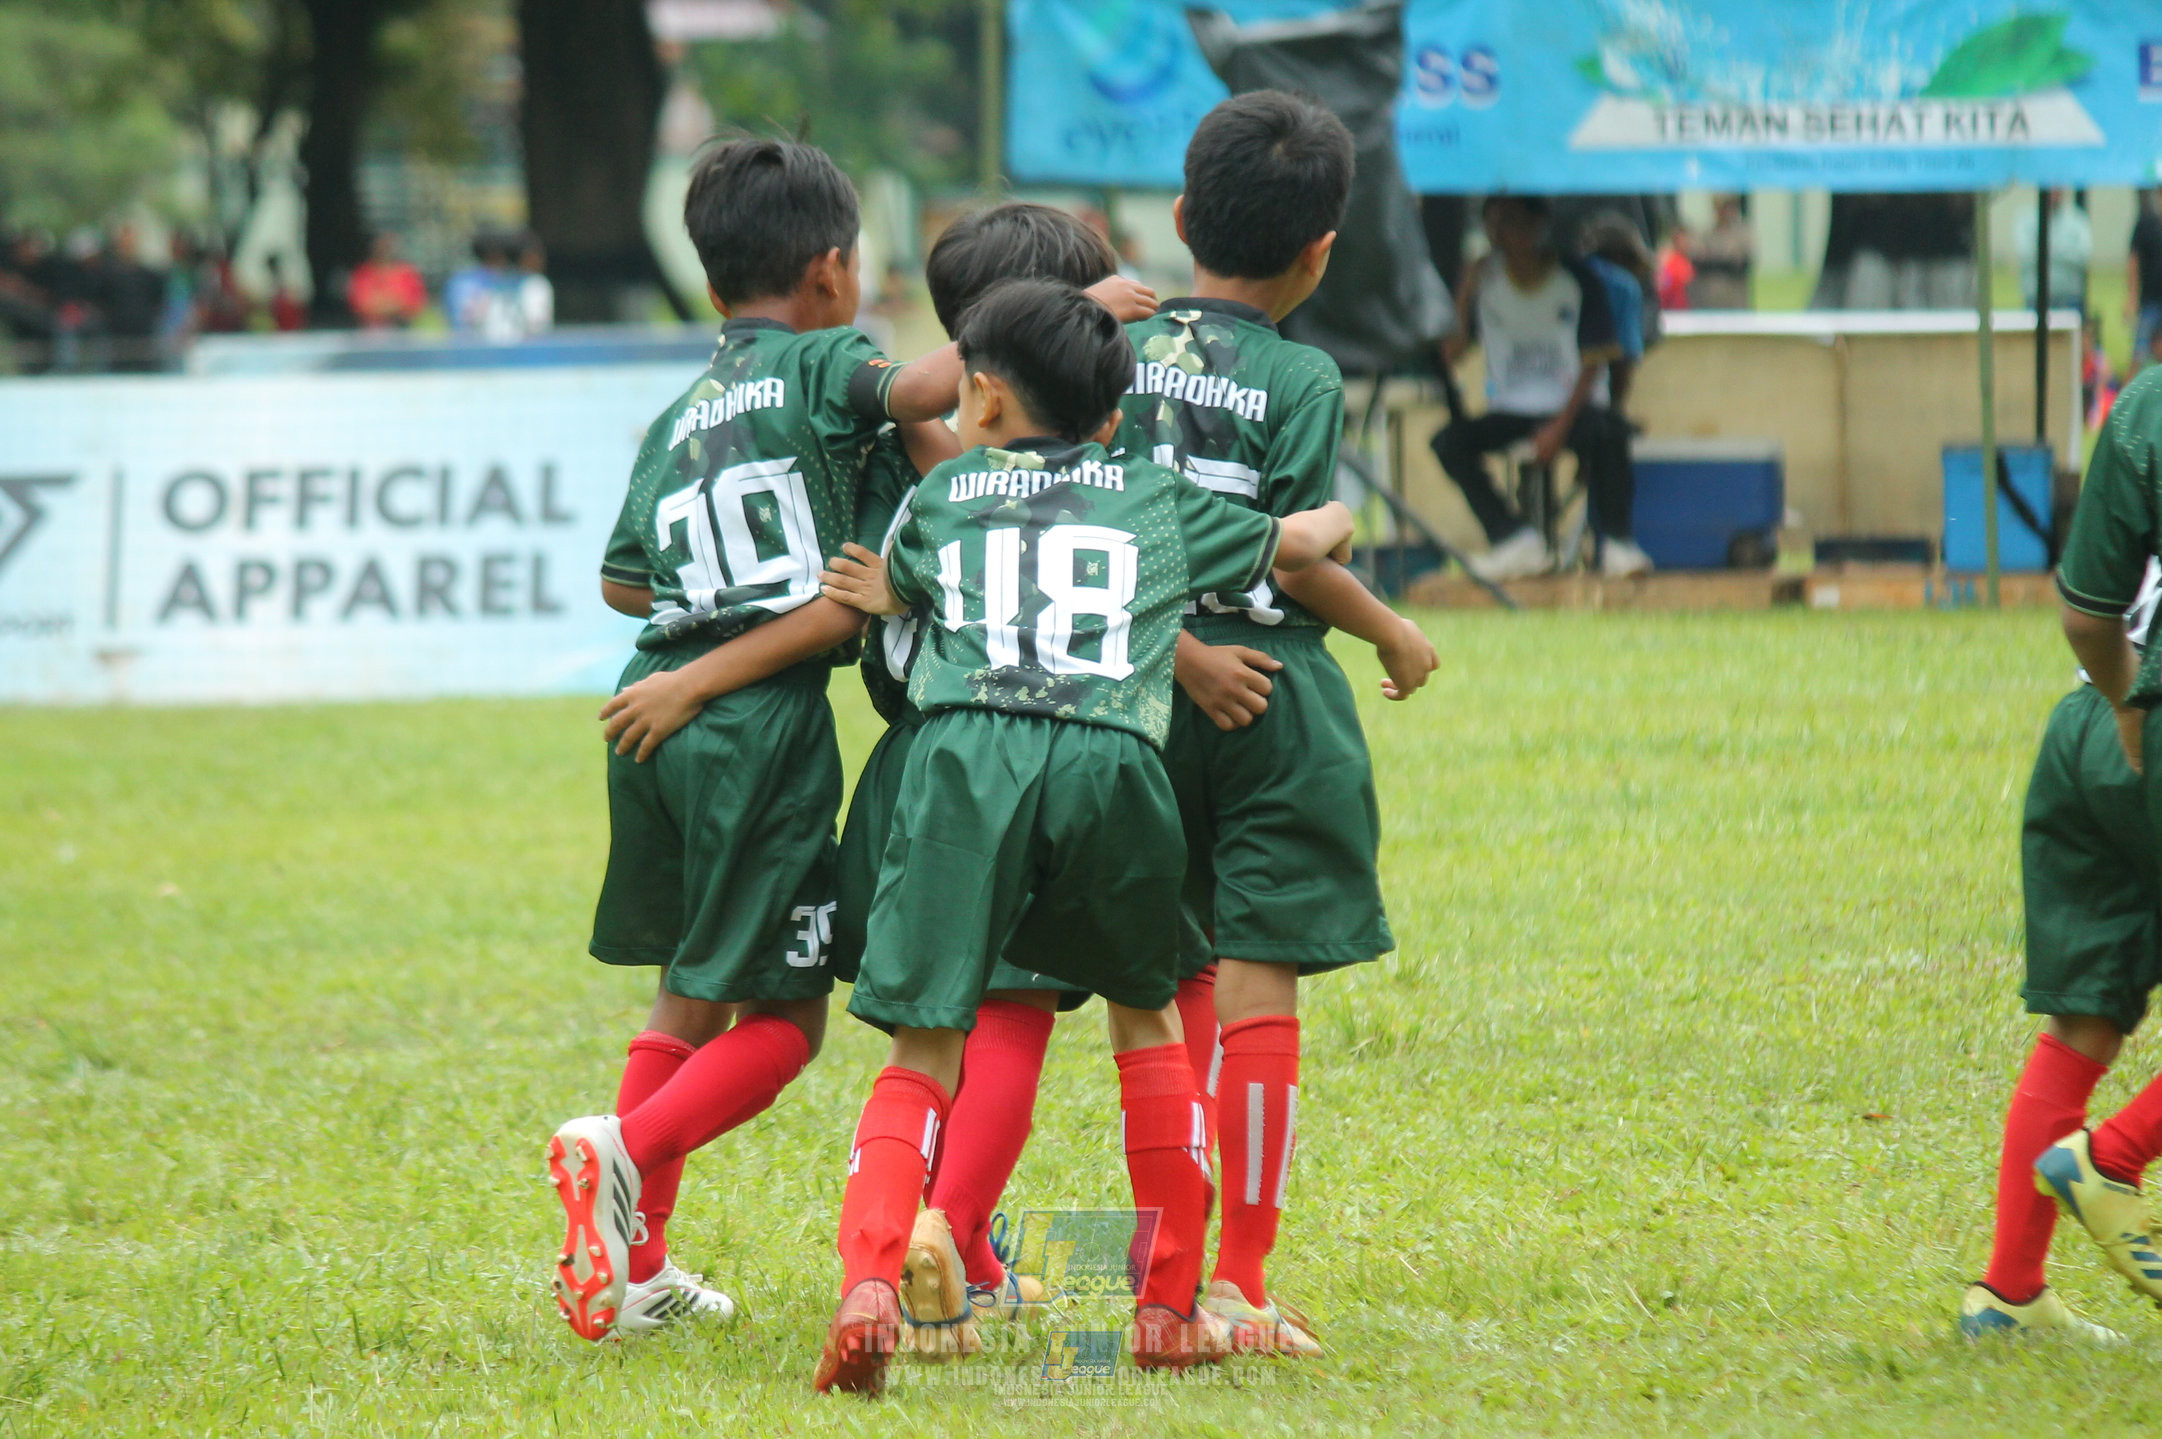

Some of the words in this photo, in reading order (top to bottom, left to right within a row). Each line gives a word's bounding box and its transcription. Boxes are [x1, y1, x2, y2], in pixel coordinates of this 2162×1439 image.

[1410, 44, 1500, 106] SS
[1656, 105, 1789, 140] TEMAN
[1802, 105, 1927, 140] SEHAT
[1944, 104, 2031, 140] KITA
[162, 464, 576, 532] OFFICIAL
[157, 553, 566, 626] APPAREL
[937, 525, 1139, 681] 48
